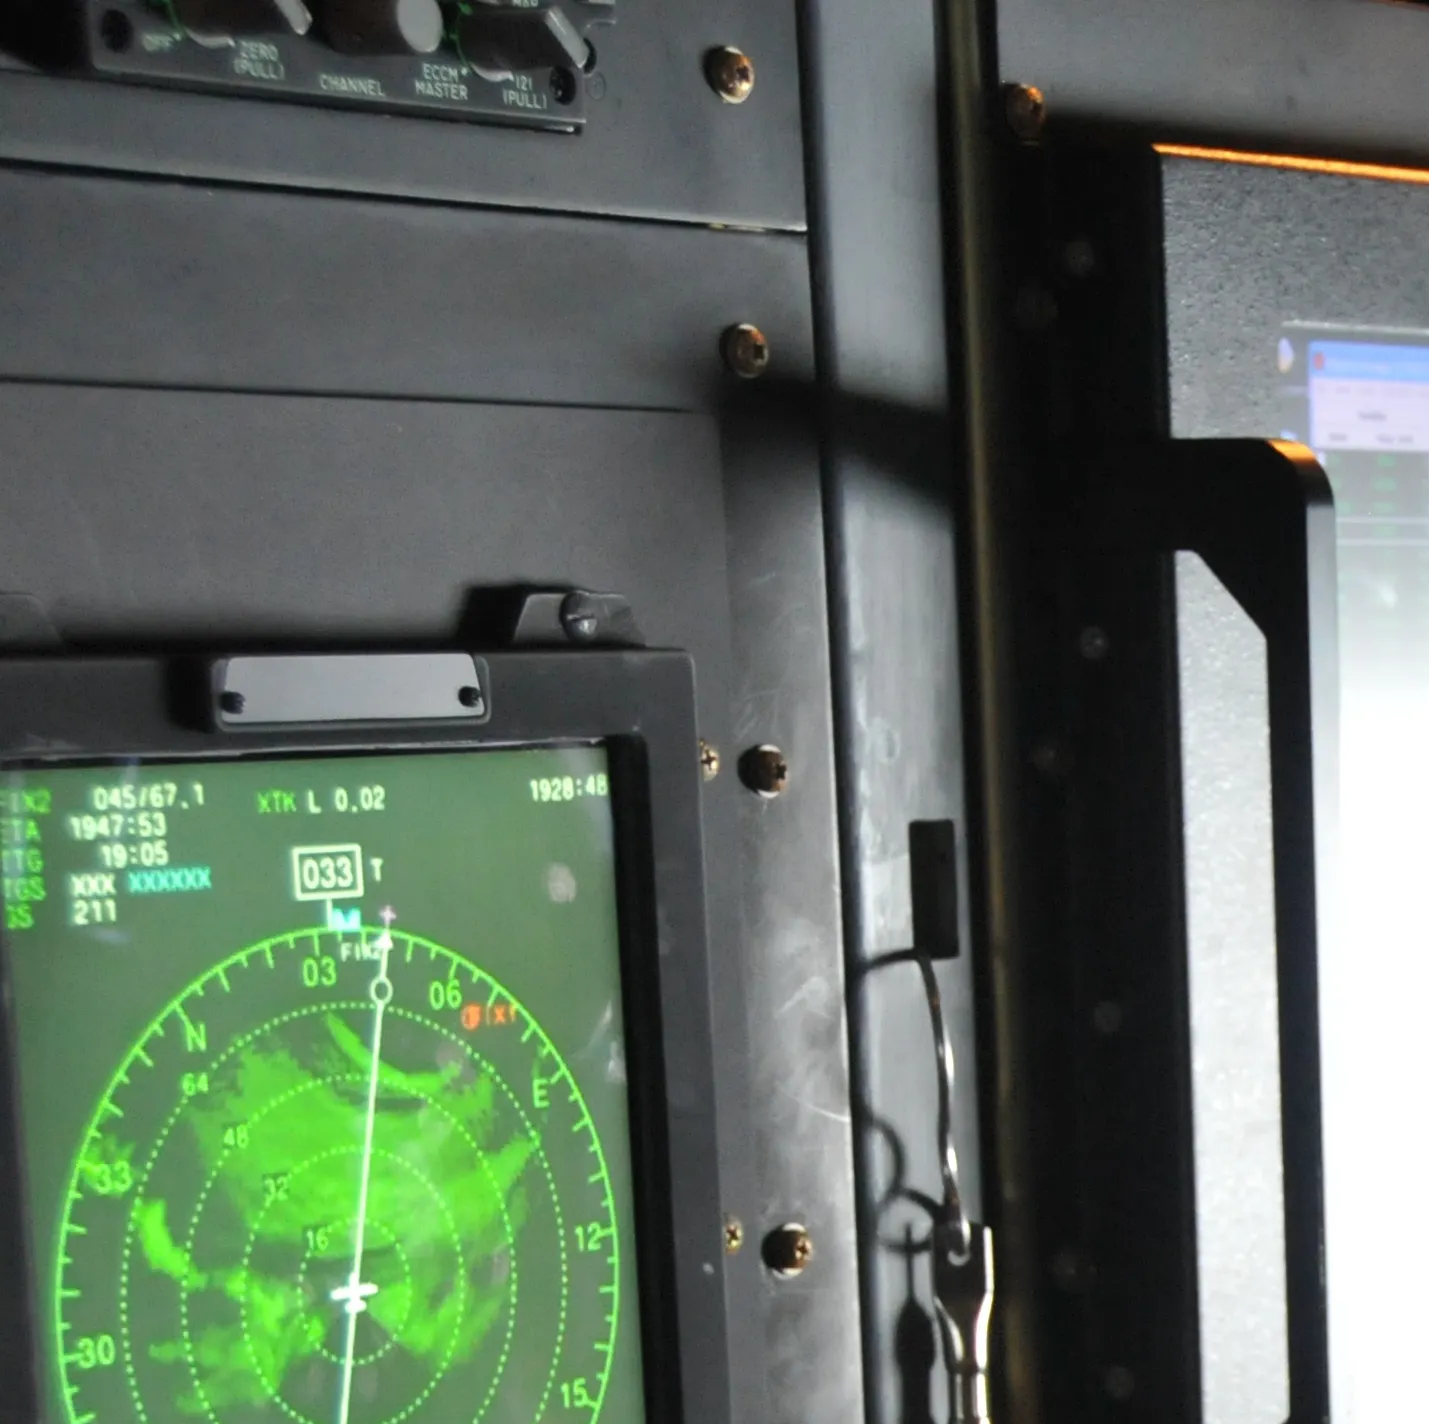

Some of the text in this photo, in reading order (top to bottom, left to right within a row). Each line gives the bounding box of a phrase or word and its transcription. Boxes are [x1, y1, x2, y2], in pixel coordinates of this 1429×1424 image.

[239, 40, 279, 61] ZERO
[234, 57, 285, 79] (PULL)
[421, 62, 459, 82] ECCM
[318, 73, 387, 97] CHANNEL
[414, 80, 468, 100] MASTER
[502, 90, 547, 110] (PULL)
[93, 781, 205, 811] 045/67.1
[257, 785, 387, 814] XTK L 0.02
[69, 811, 168, 841] 1947:53
[100, 839, 169, 869] 19:05
[71, 872, 117, 897] XXX
[301, 856, 384, 890] 033 T
[73, 898, 117, 926] 211
[302, 956, 337, 988] 03
[429, 979, 462, 1011] 06
[185, 1022, 208, 1052] N
[182, 1071, 209, 1095] 64
[532, 1078, 549, 1108] E
[223, 1125, 249, 1148] 48
[95, 1160, 133, 1194] 33
[263, 1174, 288, 1201] 32
[305, 1228, 330, 1252] 16
[574, 1225, 602, 1251] 12
[77, 1336, 116, 1367] 30
[561, 1383, 589, 1410] 15
